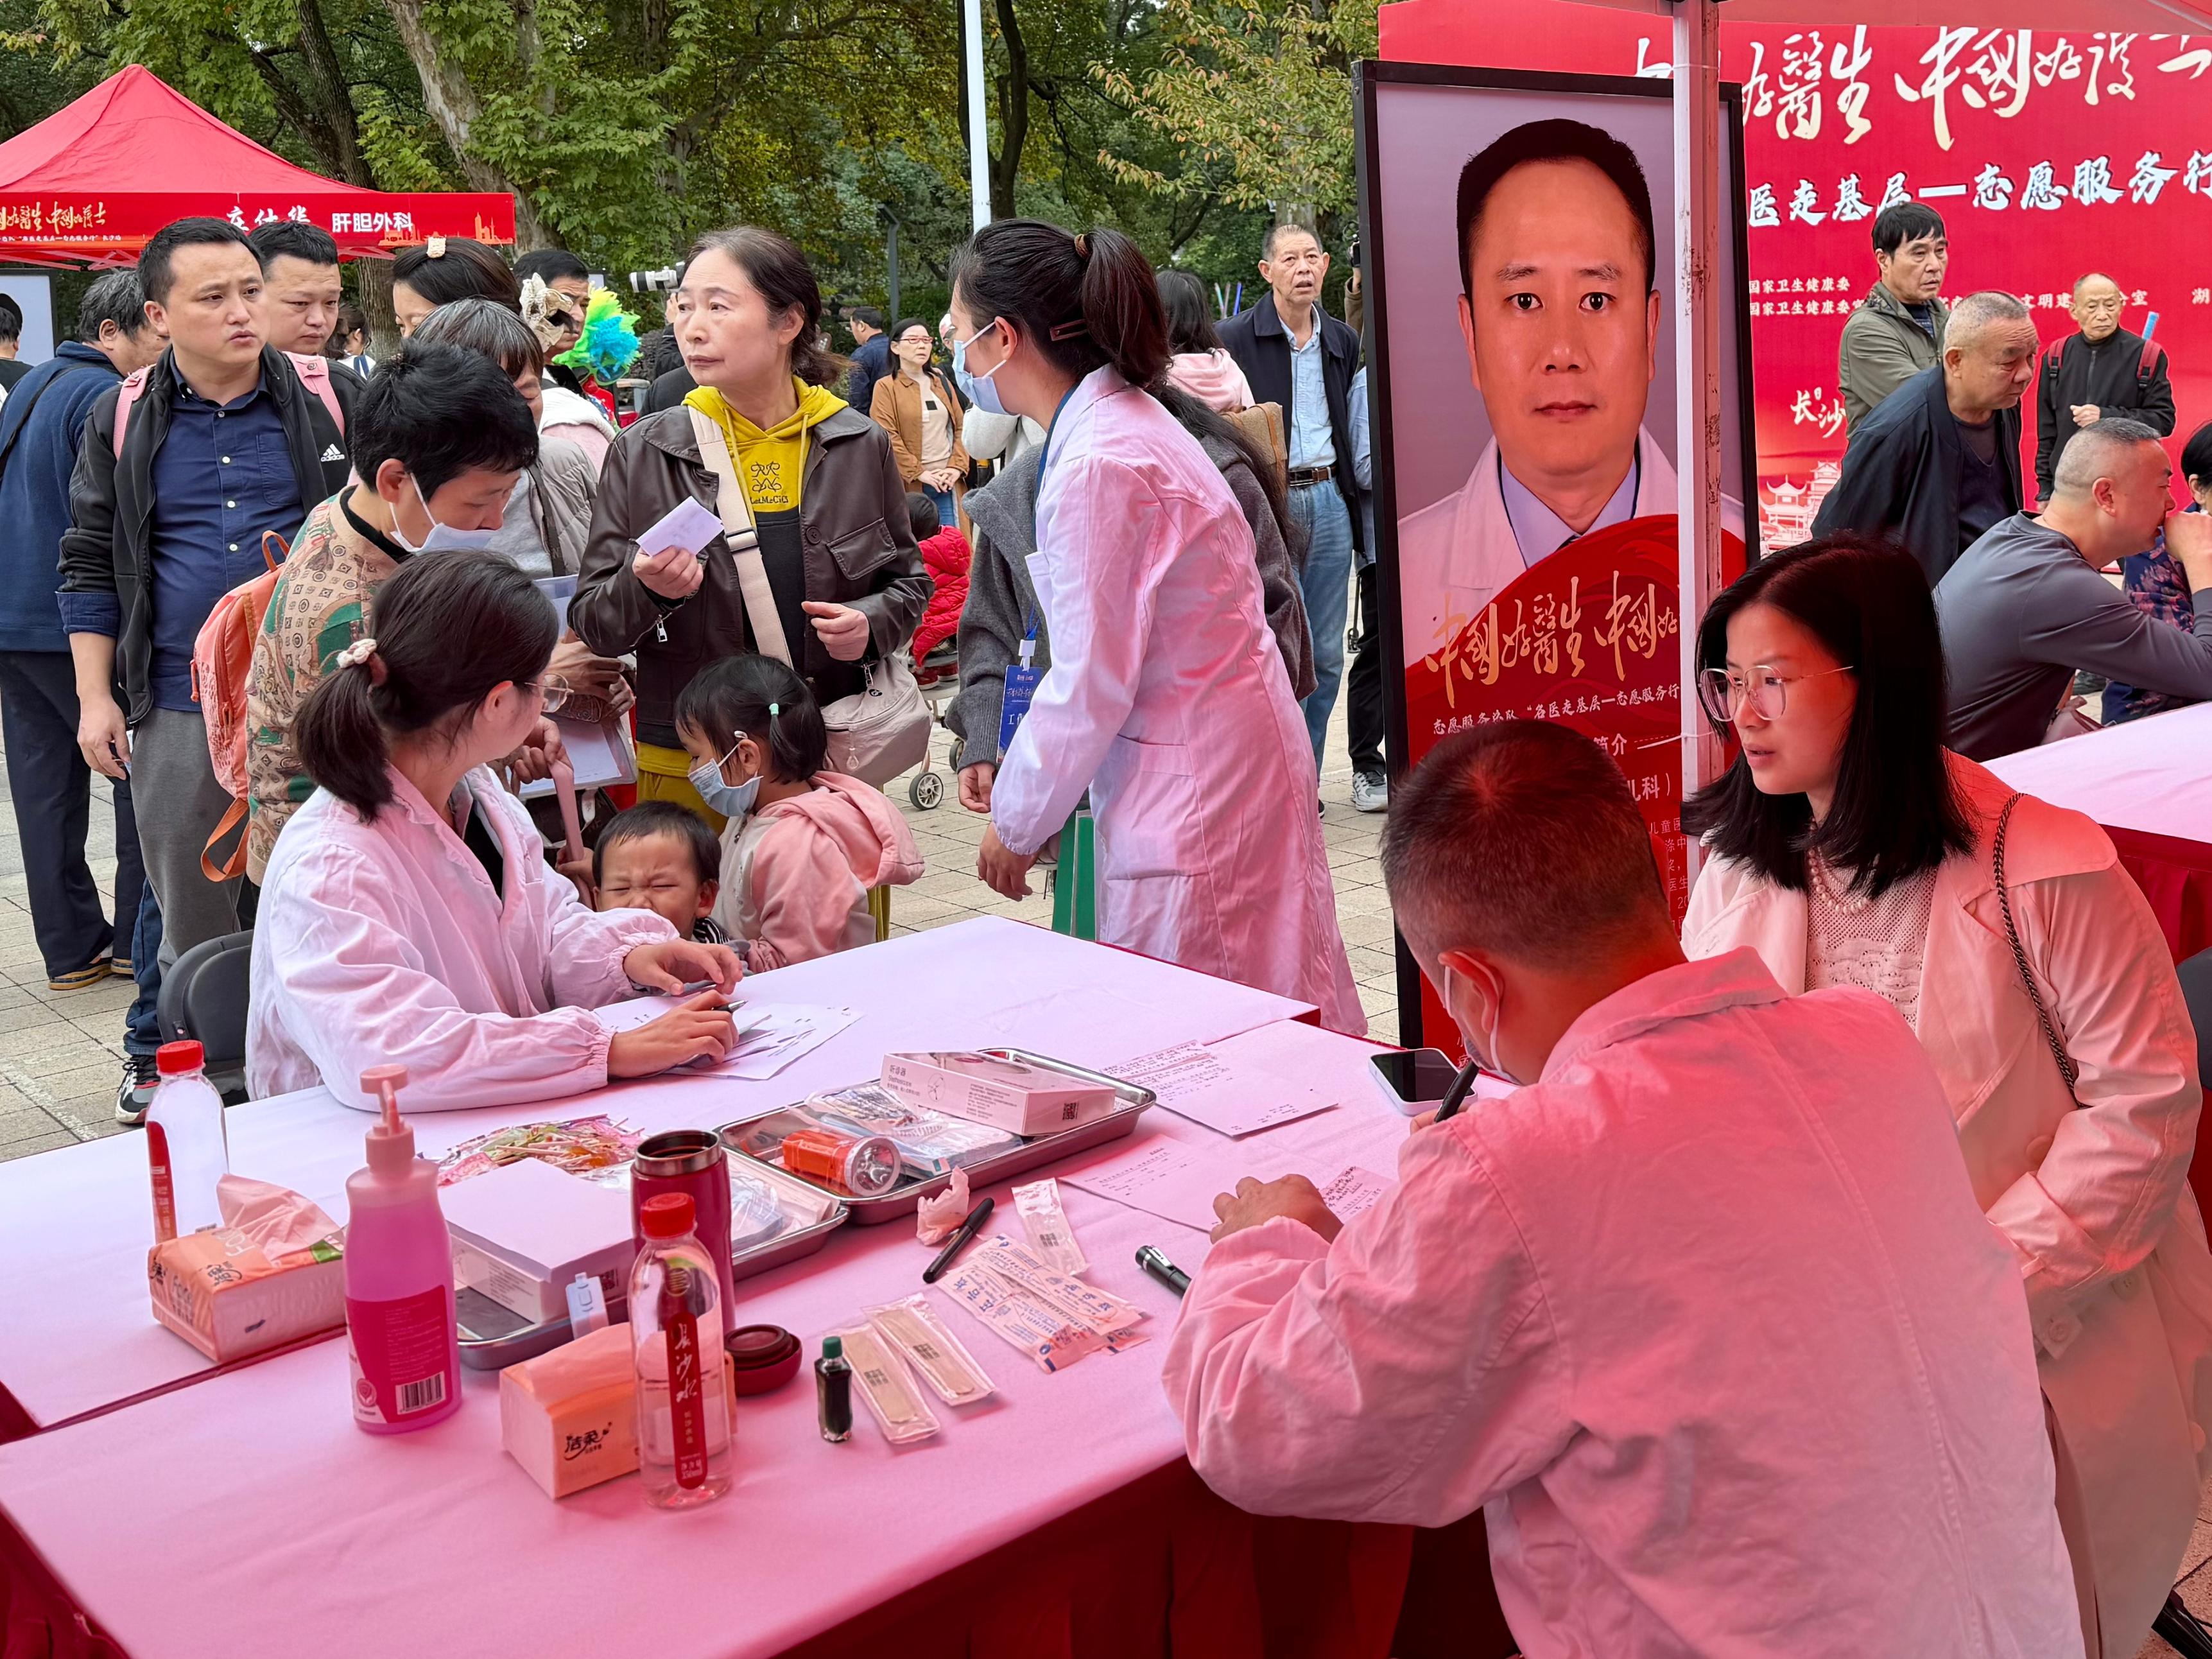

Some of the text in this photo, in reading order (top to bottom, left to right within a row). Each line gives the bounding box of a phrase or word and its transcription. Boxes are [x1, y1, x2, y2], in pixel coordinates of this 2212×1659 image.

[331, 212, 414, 233] 肝胆外科
[1749, 276, 1851, 295] 国家卫生健康委
[1790, 390, 1845, 439] 长沙
